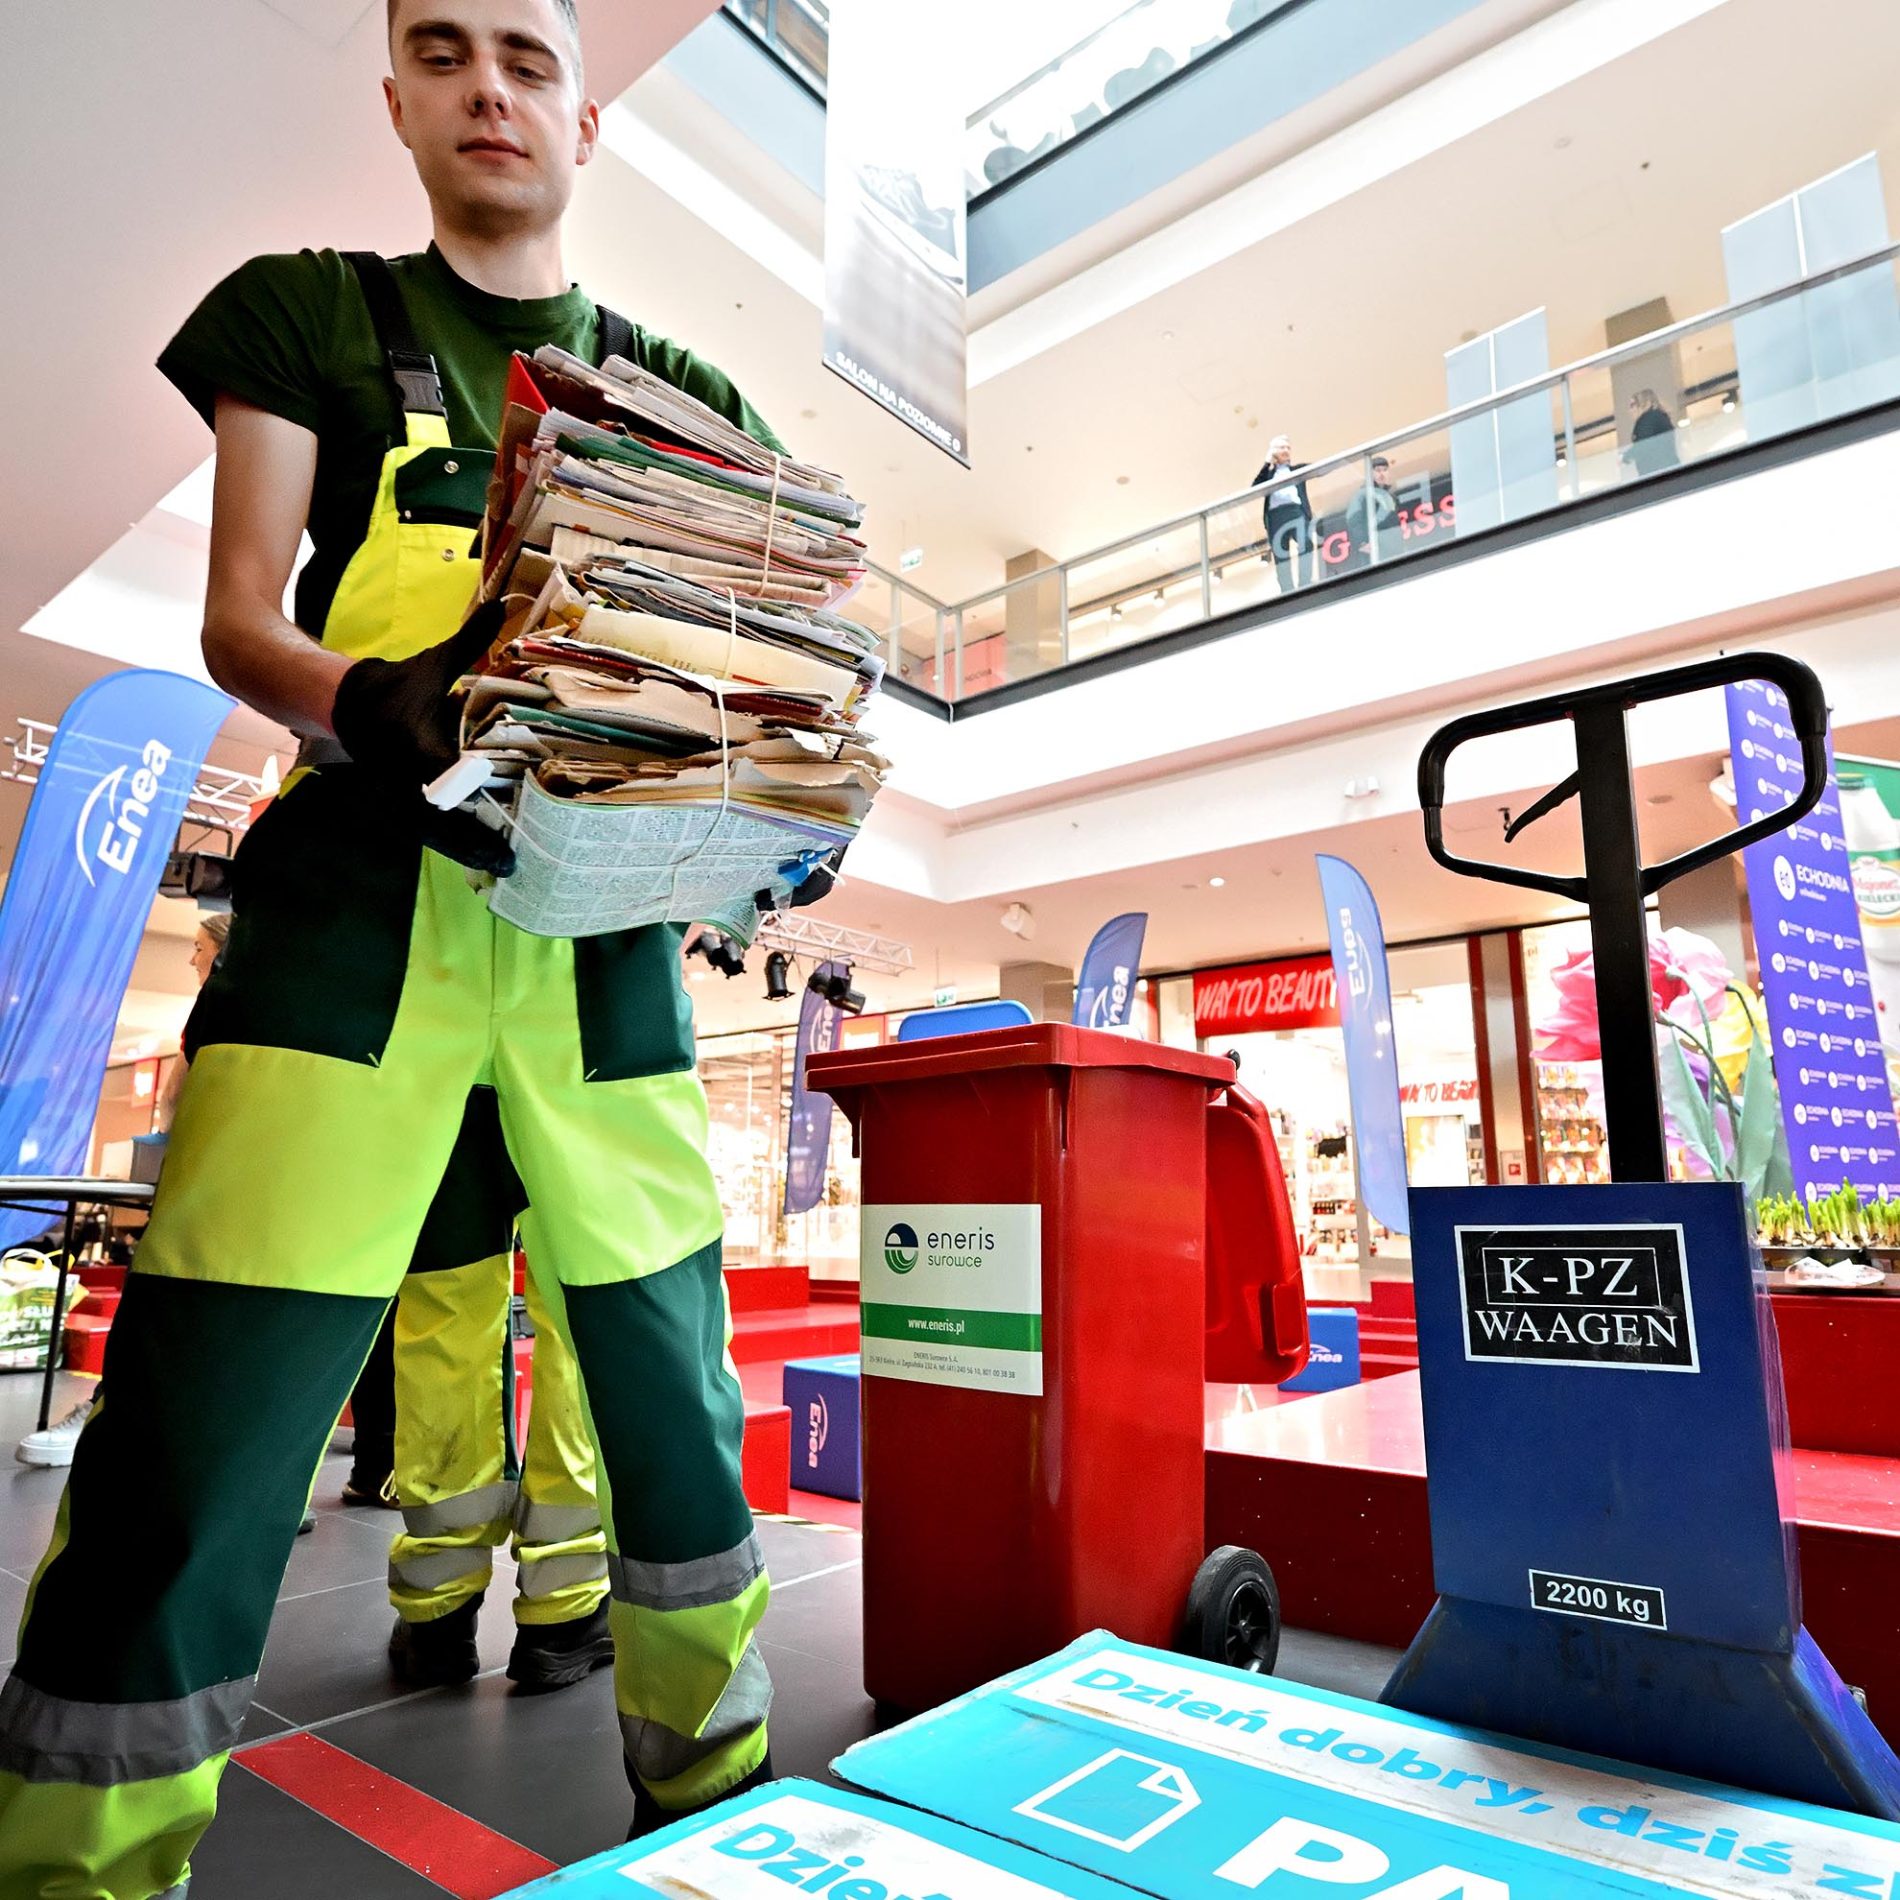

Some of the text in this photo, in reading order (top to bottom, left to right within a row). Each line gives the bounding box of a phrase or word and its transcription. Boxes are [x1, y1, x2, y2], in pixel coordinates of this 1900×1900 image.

[836, 352, 879, 392] SALON
[879, 383, 898, 406] NA
[898, 397, 953, 446] POZIOMIE
[97, 739, 172, 875] Enea
[1796, 863, 1850, 893] ECHODNIA
[1103, 965, 1130, 1028] nea
[1195, 978, 1238, 1021] WAY
[1235, 976, 1264, 1019] TO
[816, 1000, 834, 1053] Ene
[1423, 1082, 1439, 1102] TO
[927, 1226, 996, 1251] eneris
[927, 1254, 983, 1269] surowce
[1498, 1257, 1638, 1297] K-PZ
[907, 1317, 965, 1336] www.eneris.pl
[1475, 1310, 1678, 1349] WAAGEN
[1308, 1351, 1343, 1363] nea
[1546, 1580, 1650, 1622] 2200 kg
[1072, 1668, 1271, 1734] Dzień
[1278, 1727, 1556, 1815] dobry,
[1576, 1804, 1796, 1875] dziś
[710, 1822, 953, 1900] Dzie
